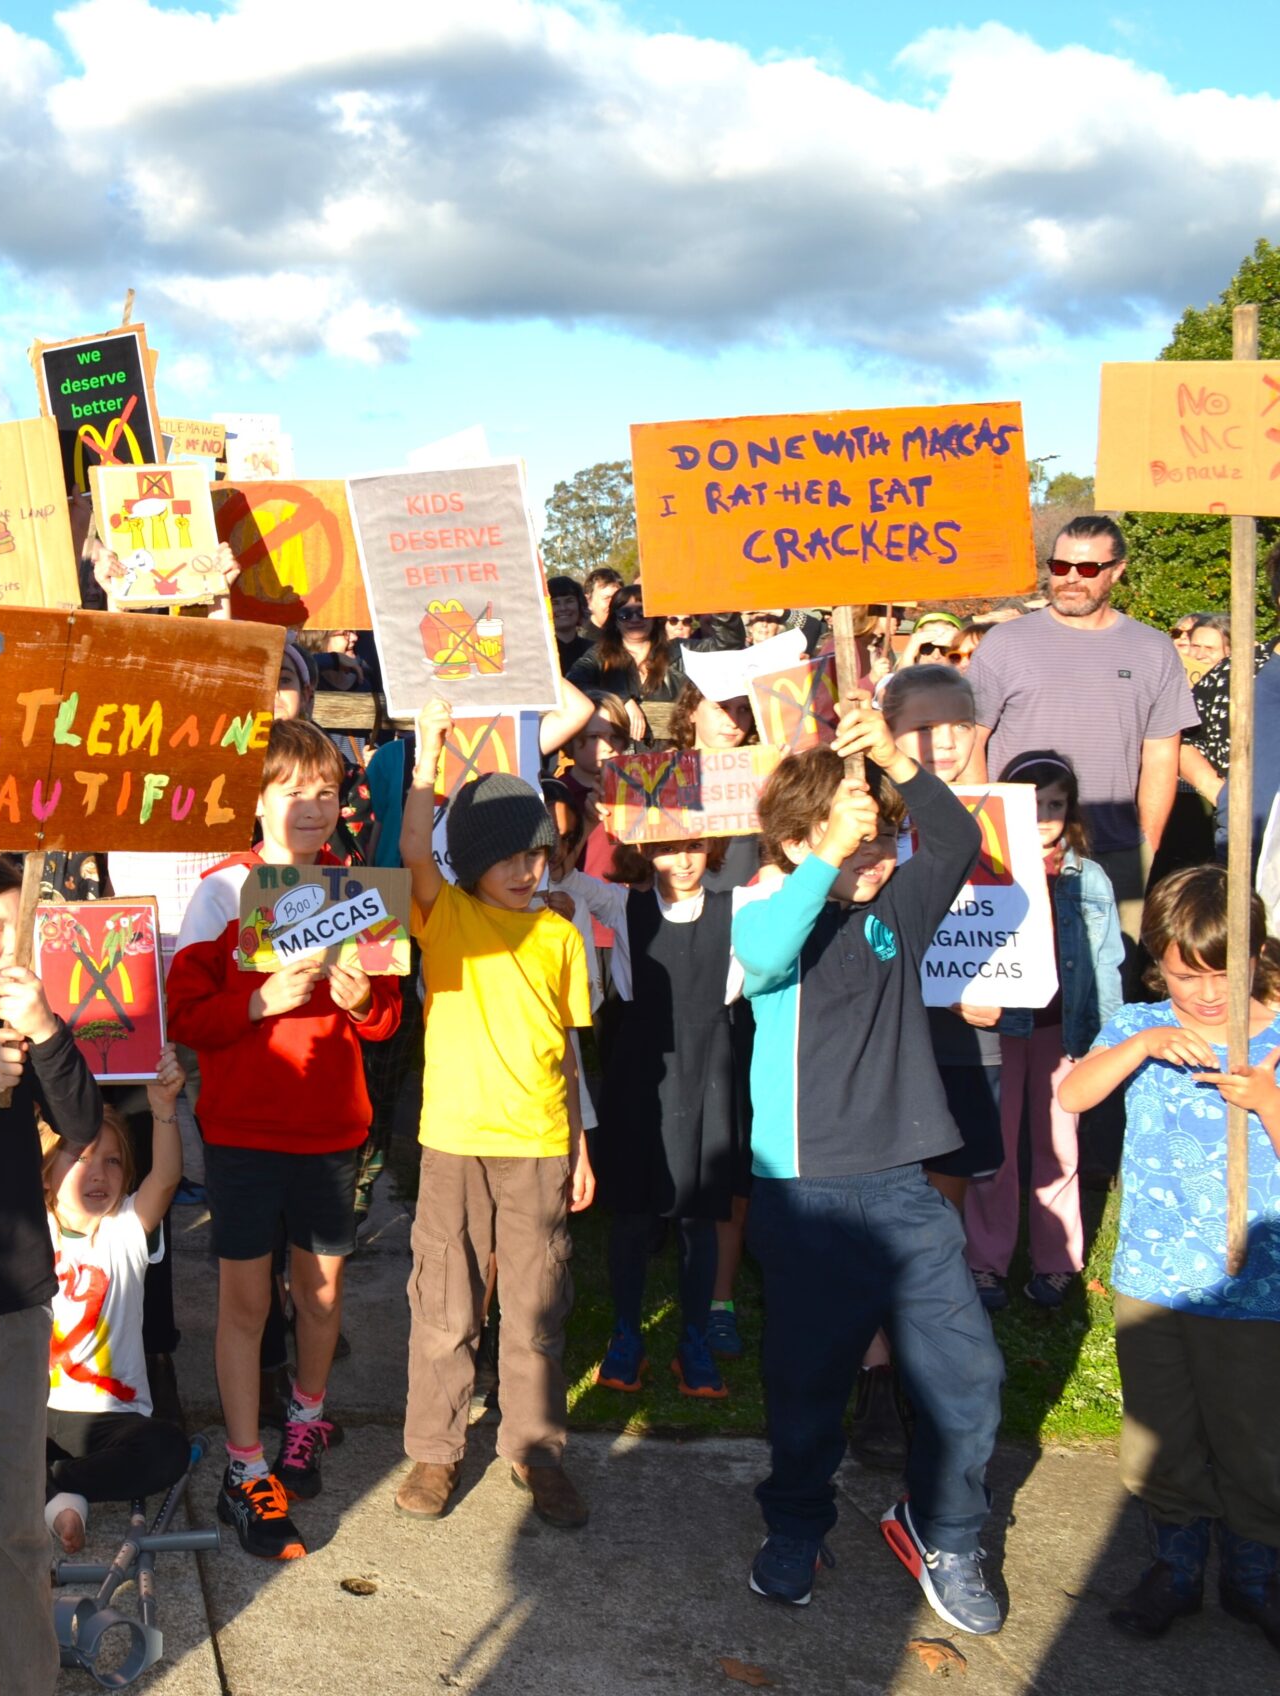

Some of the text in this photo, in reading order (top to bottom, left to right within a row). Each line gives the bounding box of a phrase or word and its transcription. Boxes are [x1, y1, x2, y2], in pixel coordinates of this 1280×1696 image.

[76, 349, 102, 365] we
[60, 370, 127, 395] deserve
[71, 397, 124, 419] better
[668, 417, 1022, 471] DONE WITH MACCAS
[405, 492, 465, 516] KIDS
[657, 475, 933, 518] I RATHER EAT
[388, 525, 504, 554] DESERVE
[742, 519, 962, 569] CRACKERS
[404, 561, 500, 588] BETTER
[278, 897, 379, 957] MACCAS
[925, 961, 1024, 979] MACCAS
